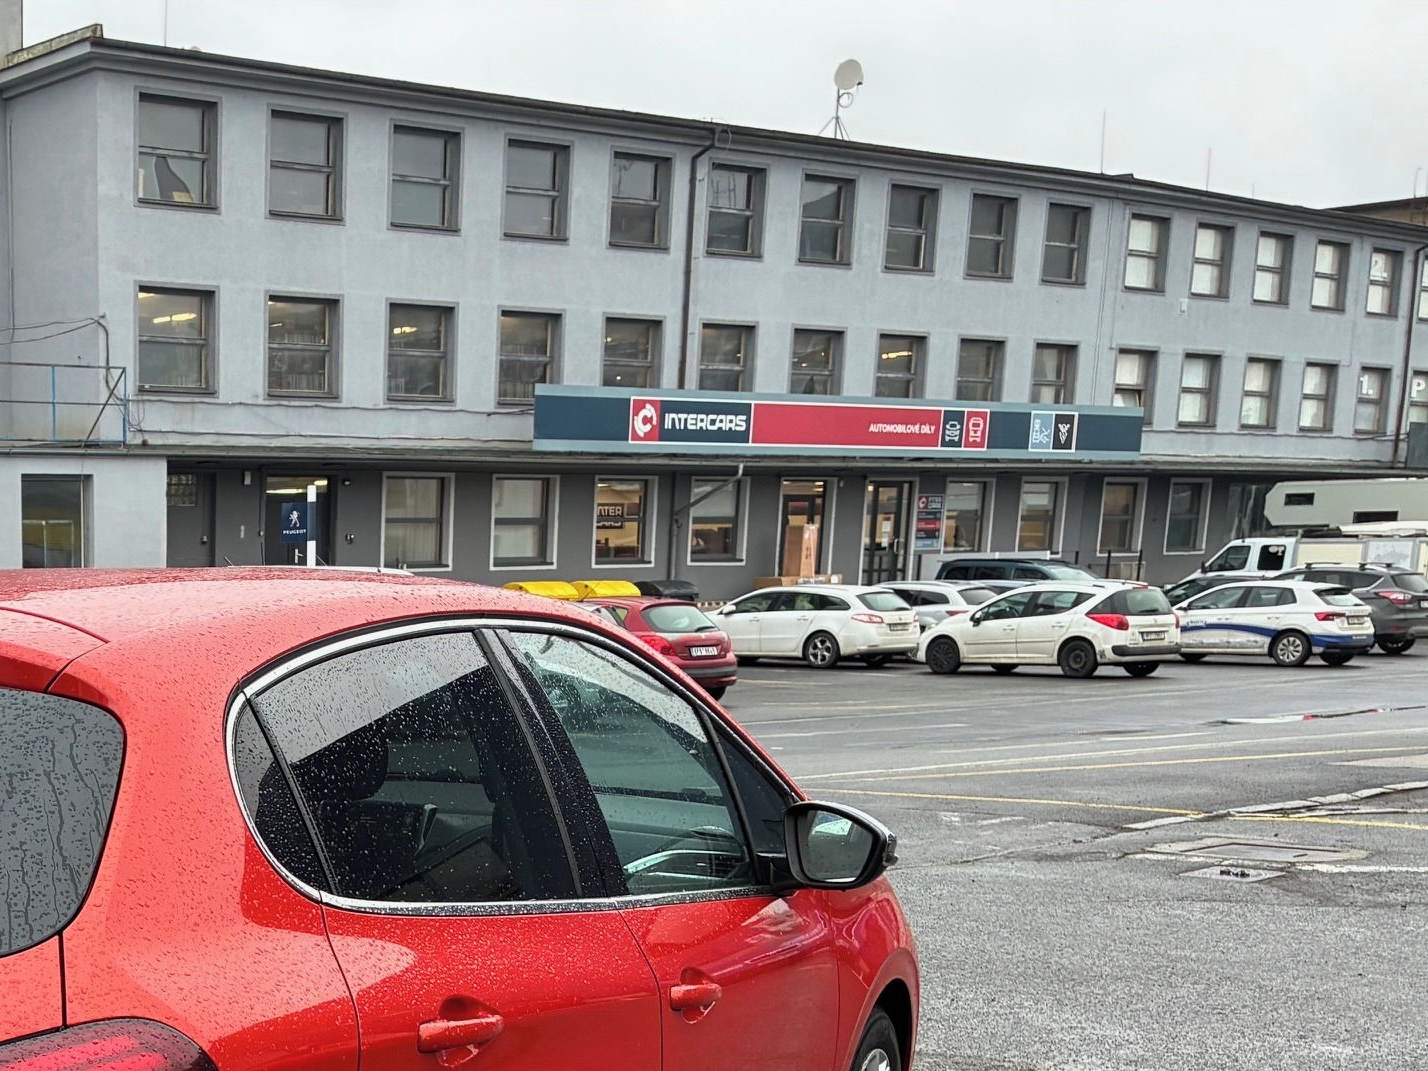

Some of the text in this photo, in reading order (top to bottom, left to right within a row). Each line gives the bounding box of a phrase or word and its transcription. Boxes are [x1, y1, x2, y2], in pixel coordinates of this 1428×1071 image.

[664, 413, 747, 431] INTERCARS
[868, 423, 936, 434] AUTOMOBILOVÉ DÍLY
[597, 505, 622, 516] NTER
